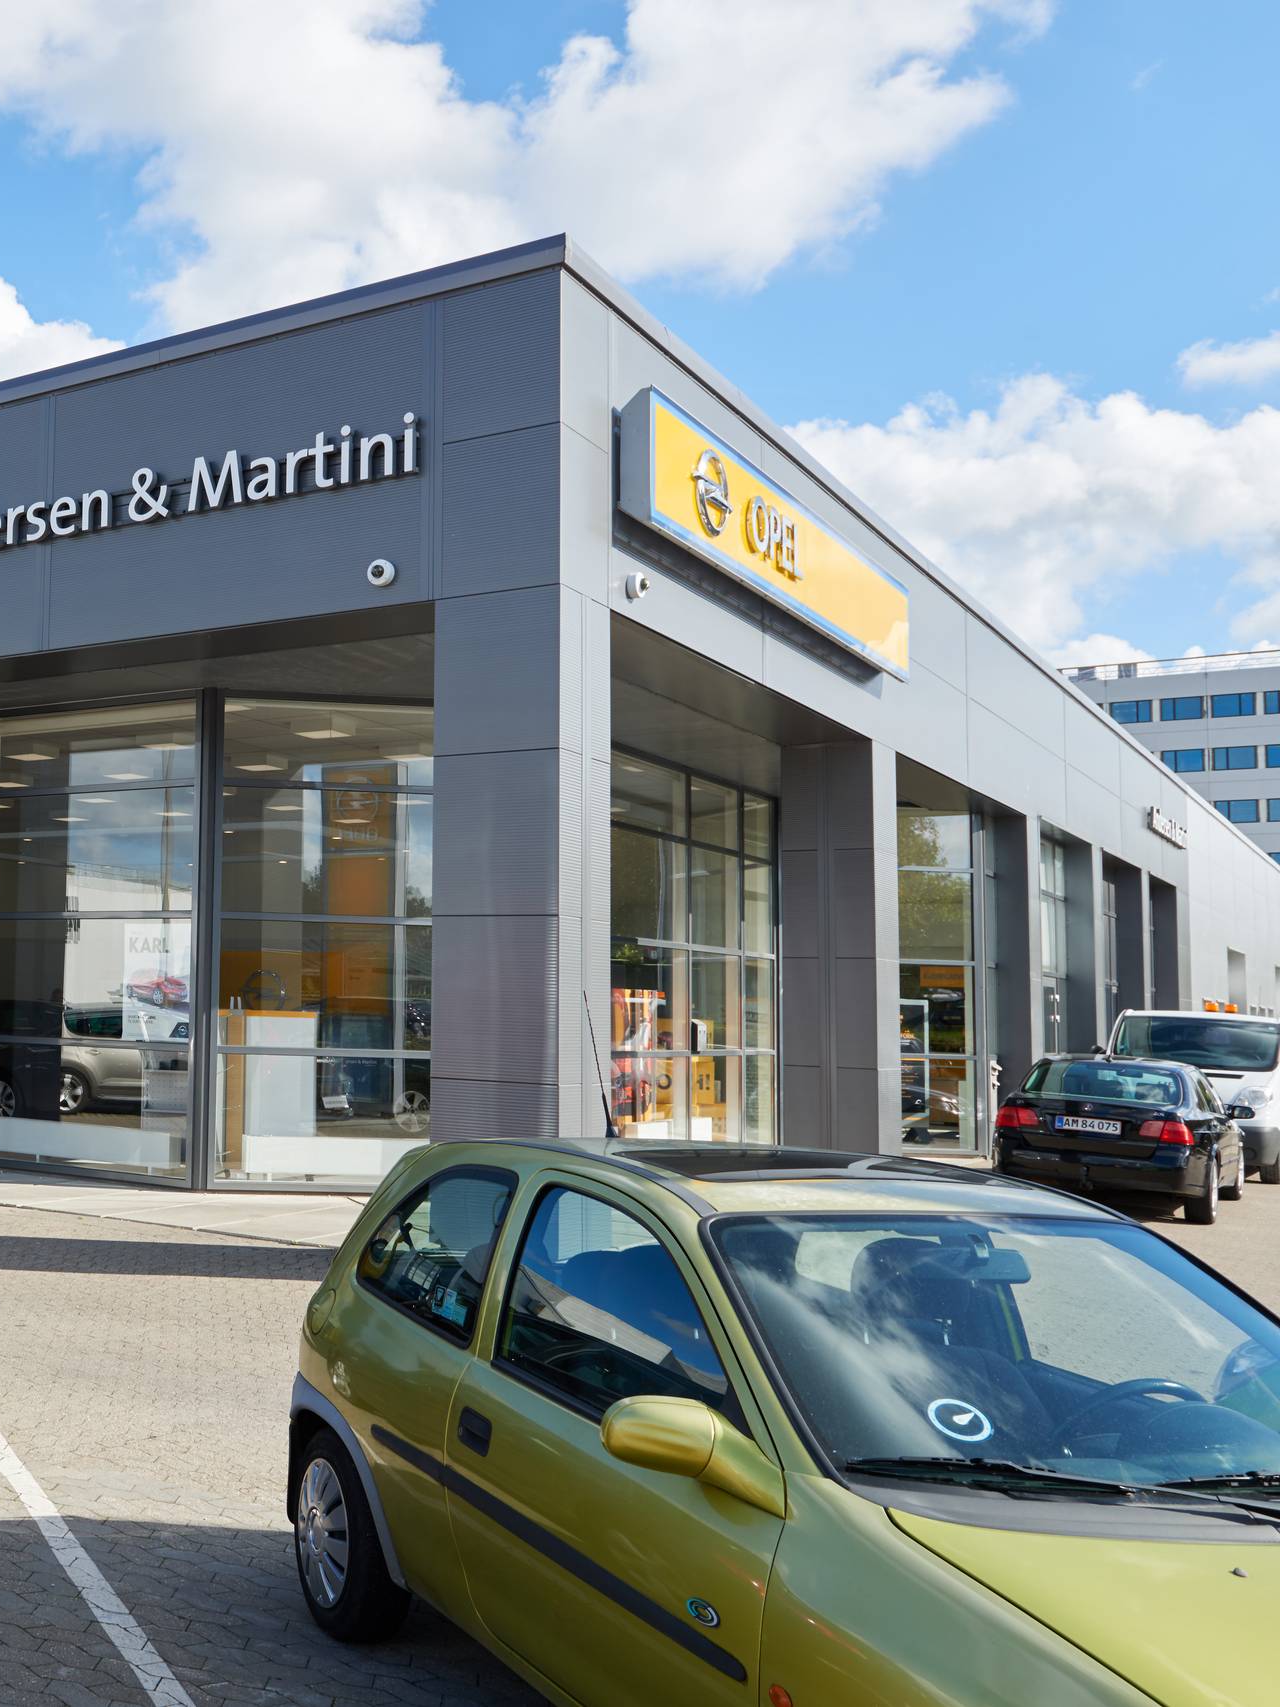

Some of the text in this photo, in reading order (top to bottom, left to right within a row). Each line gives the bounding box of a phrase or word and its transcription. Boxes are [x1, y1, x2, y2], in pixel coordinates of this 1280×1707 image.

[128, 467, 169, 522] &
[187, 412, 416, 512] Martini
[749, 496, 803, 579] OPEL
[129, 937, 170, 953] KARL
[1063, 1118, 1119, 1132] AM 84 075
